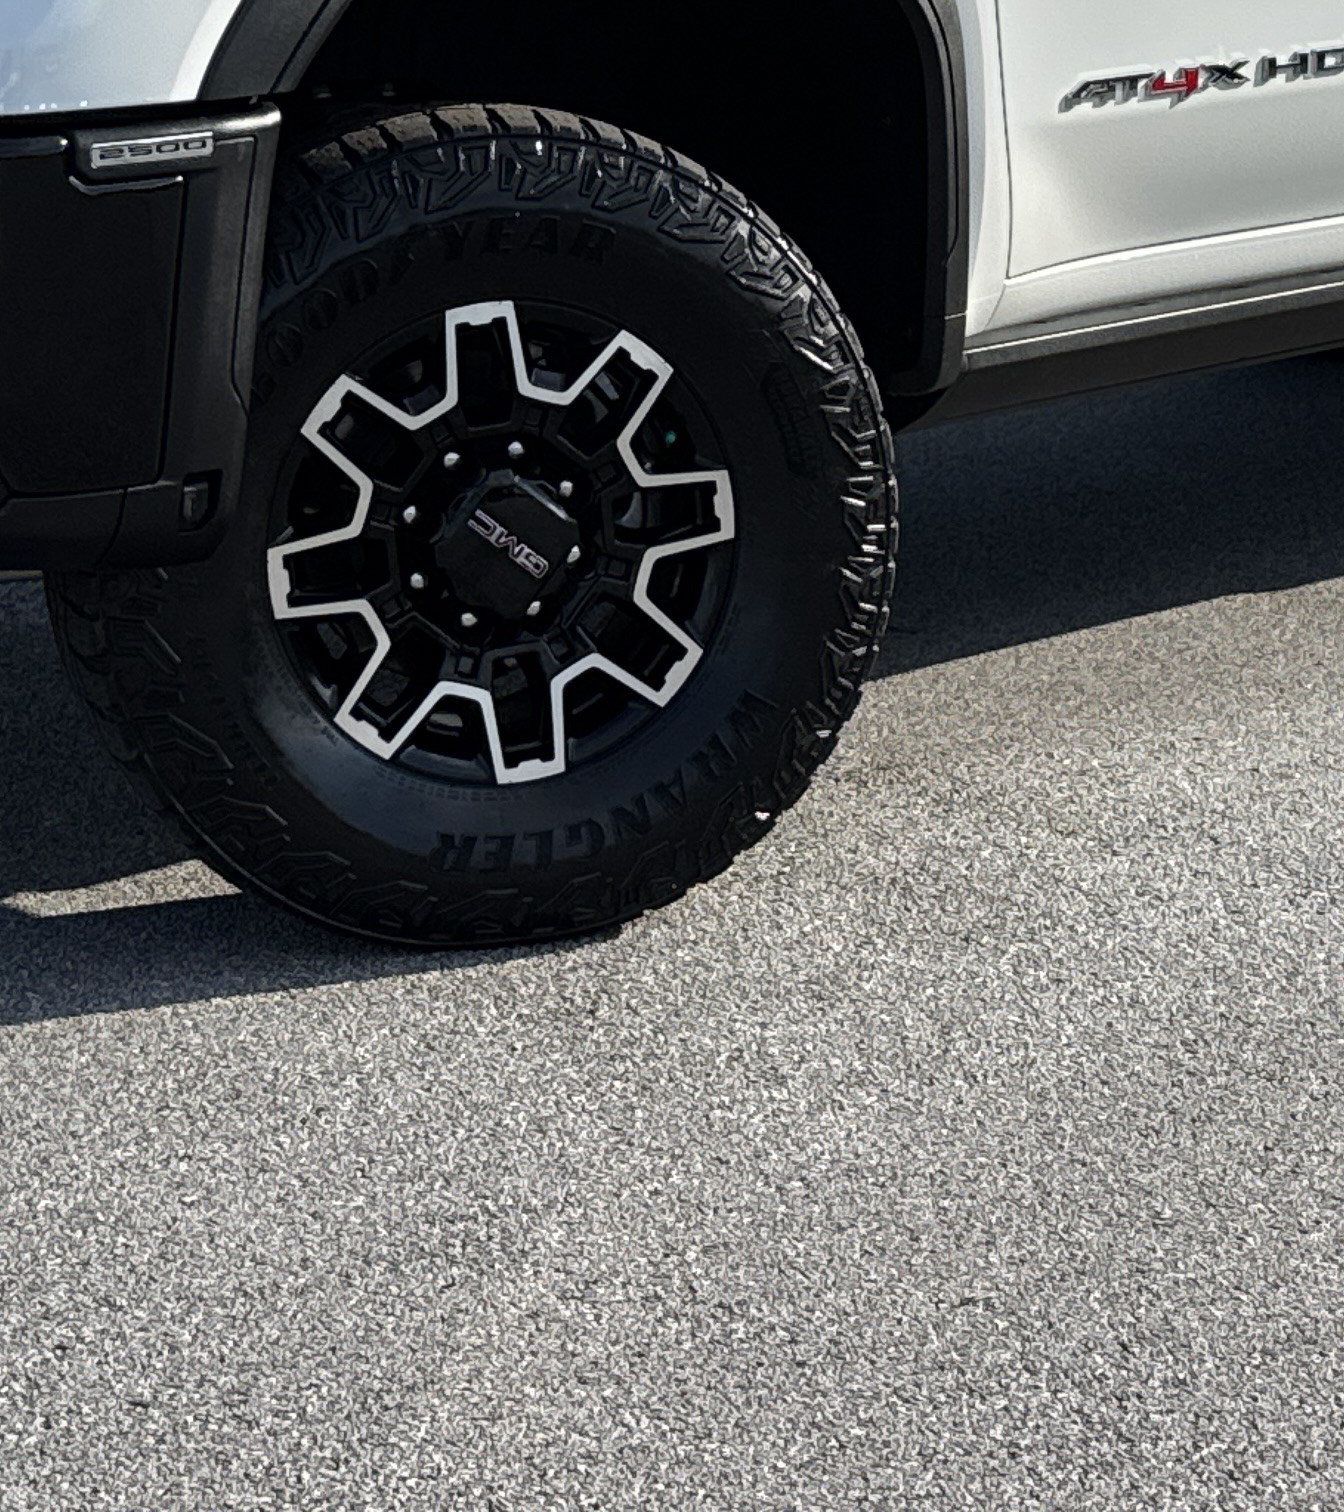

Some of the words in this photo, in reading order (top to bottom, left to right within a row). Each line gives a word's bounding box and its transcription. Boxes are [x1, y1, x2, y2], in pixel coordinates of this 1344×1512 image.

[1058, 60, 1251, 115] AT4X
[99, 141, 207, 161] 2500
[467, 508, 549, 579] GMC
[431, 688, 778, 874] WRANGLER
